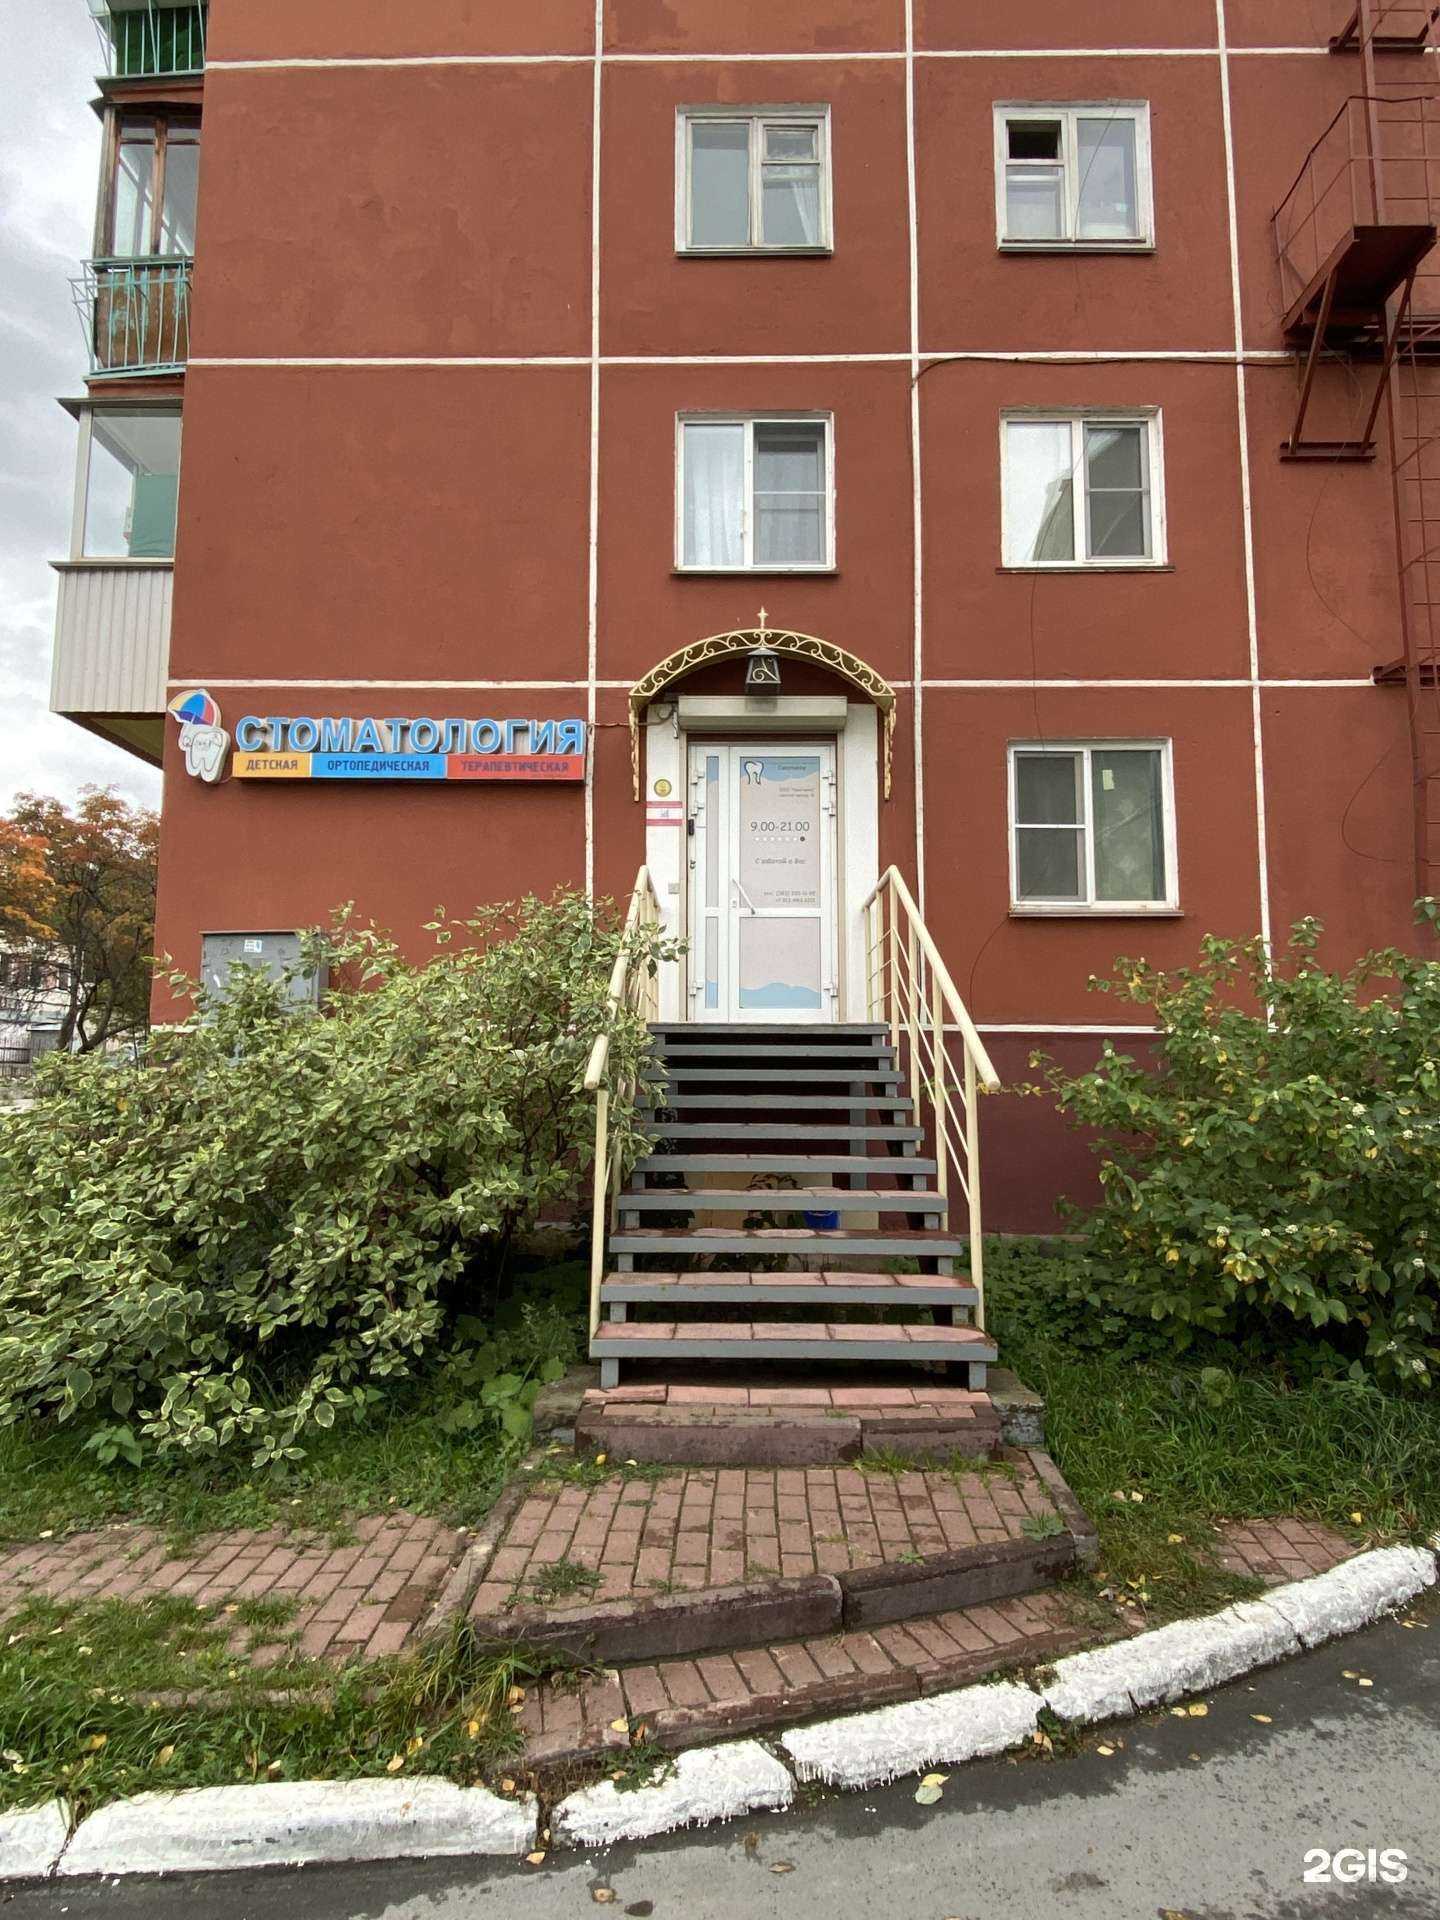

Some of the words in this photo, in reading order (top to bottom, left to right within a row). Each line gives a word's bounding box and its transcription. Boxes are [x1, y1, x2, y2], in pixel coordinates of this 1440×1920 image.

[235, 716, 583, 754] СТОМАТОЛОГИЯ
[246, 760, 298, 772] ДЕТСКАЯ
[327, 760, 430, 773] ОРТОПЕДИЧЕСКАЯ
[461, 761, 569, 773] ТЕРАПЕВТИЧЕСКАЯ
